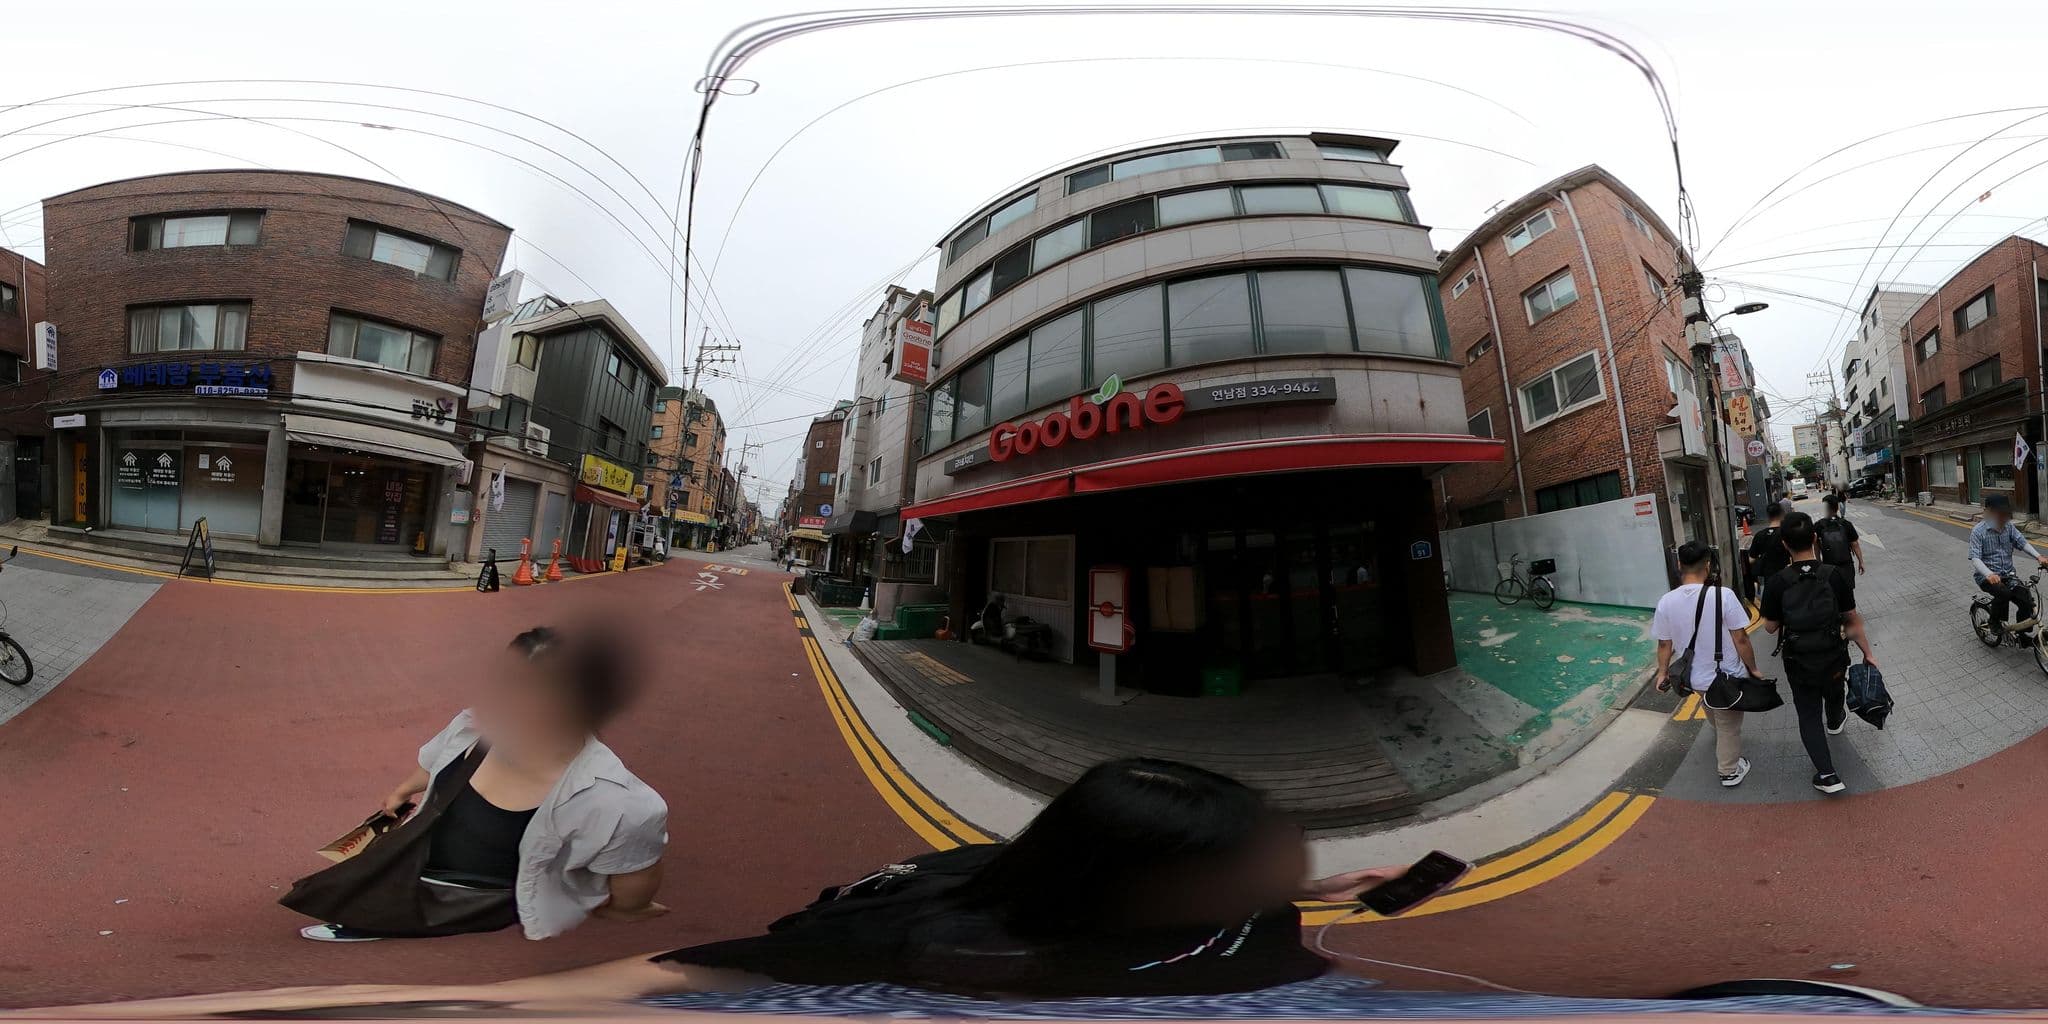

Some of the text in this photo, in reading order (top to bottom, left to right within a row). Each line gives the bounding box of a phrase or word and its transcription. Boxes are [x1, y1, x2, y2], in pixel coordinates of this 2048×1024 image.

[198, 362, 272, 388] 부동산
[1211, 386, 1246, 401] 연남점
[989, 382, 1185, 462] Goobne
[1417, 549, 1426, 557] 91
